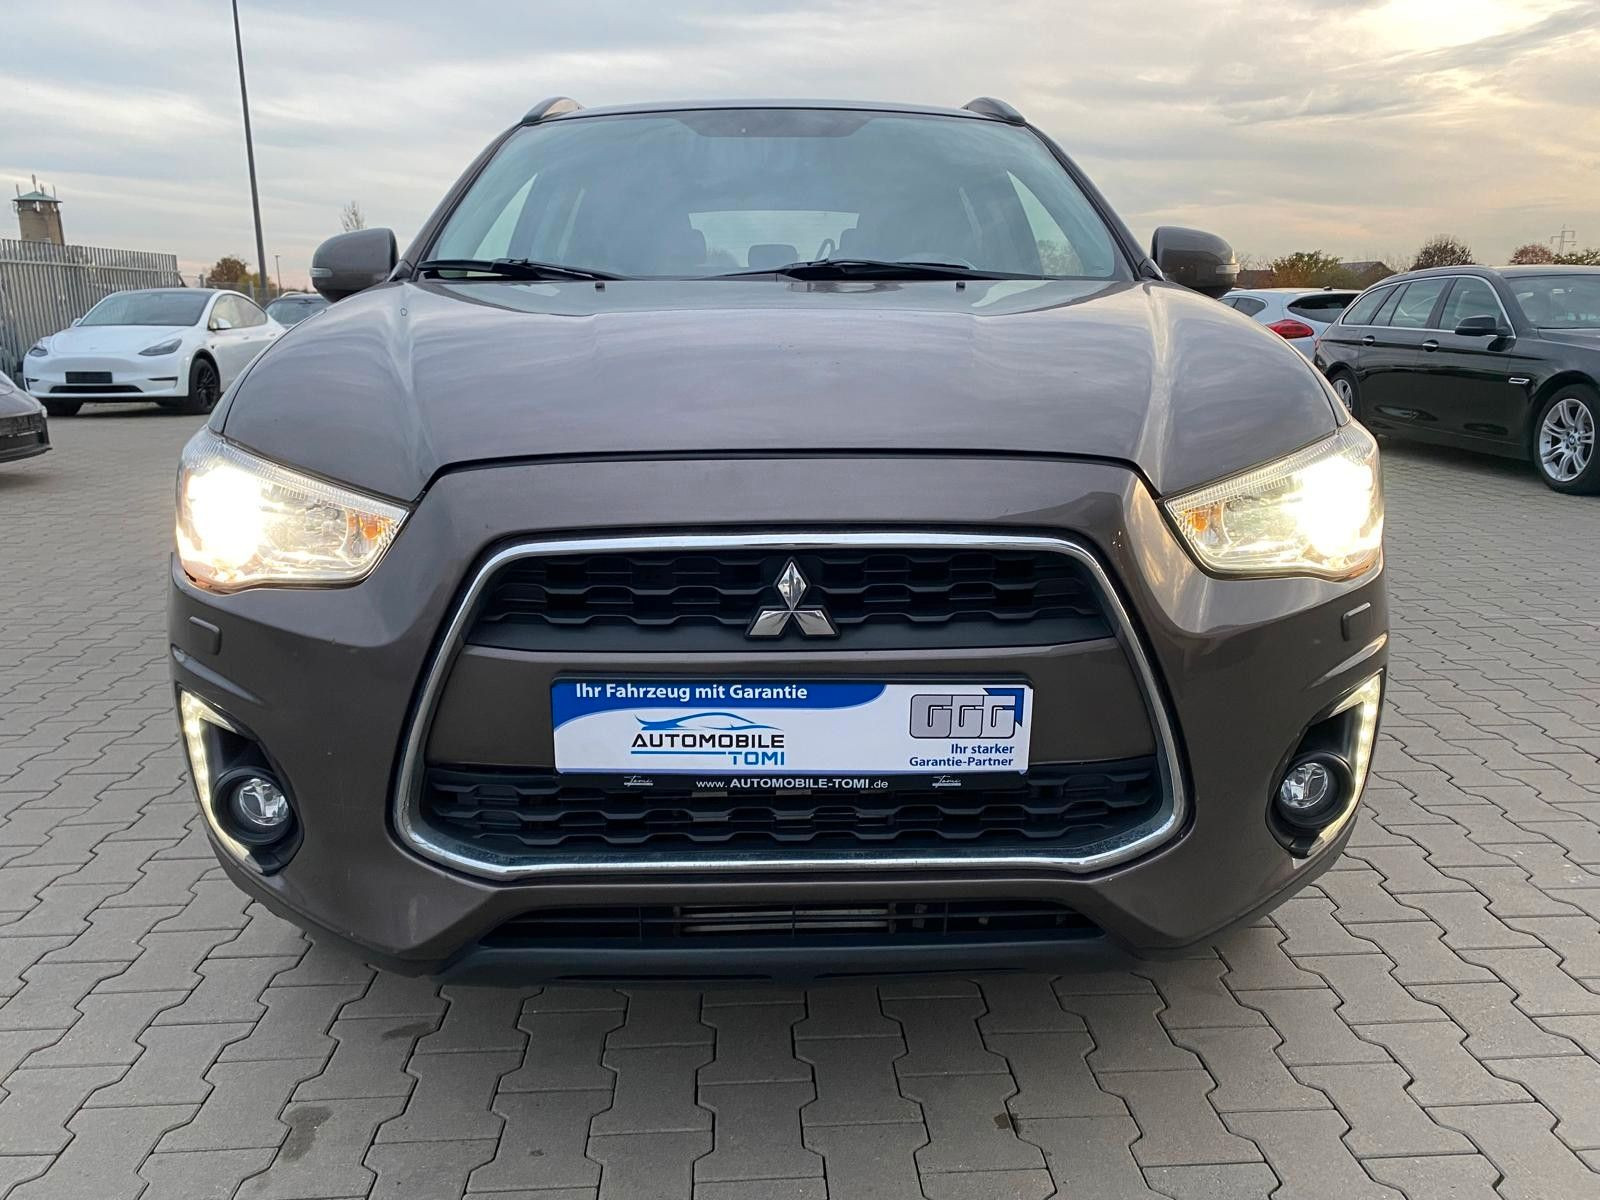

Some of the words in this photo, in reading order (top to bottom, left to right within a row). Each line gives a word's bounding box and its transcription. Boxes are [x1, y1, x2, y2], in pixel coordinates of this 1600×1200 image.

[576, 684, 602, 699] Ihr
[606, 684, 689, 703] Fahrzeug
[695, 684, 726, 700] mit
[731, 685, 808, 700] Garantie
[631, 734, 785, 749] AUTOMOBILE
[951, 743, 969, 754] Ihr
[971, 743, 1015, 754] starker
[728, 752, 785, 765] TOMI
[909, 757, 1014, 767] Garantie-Partner
